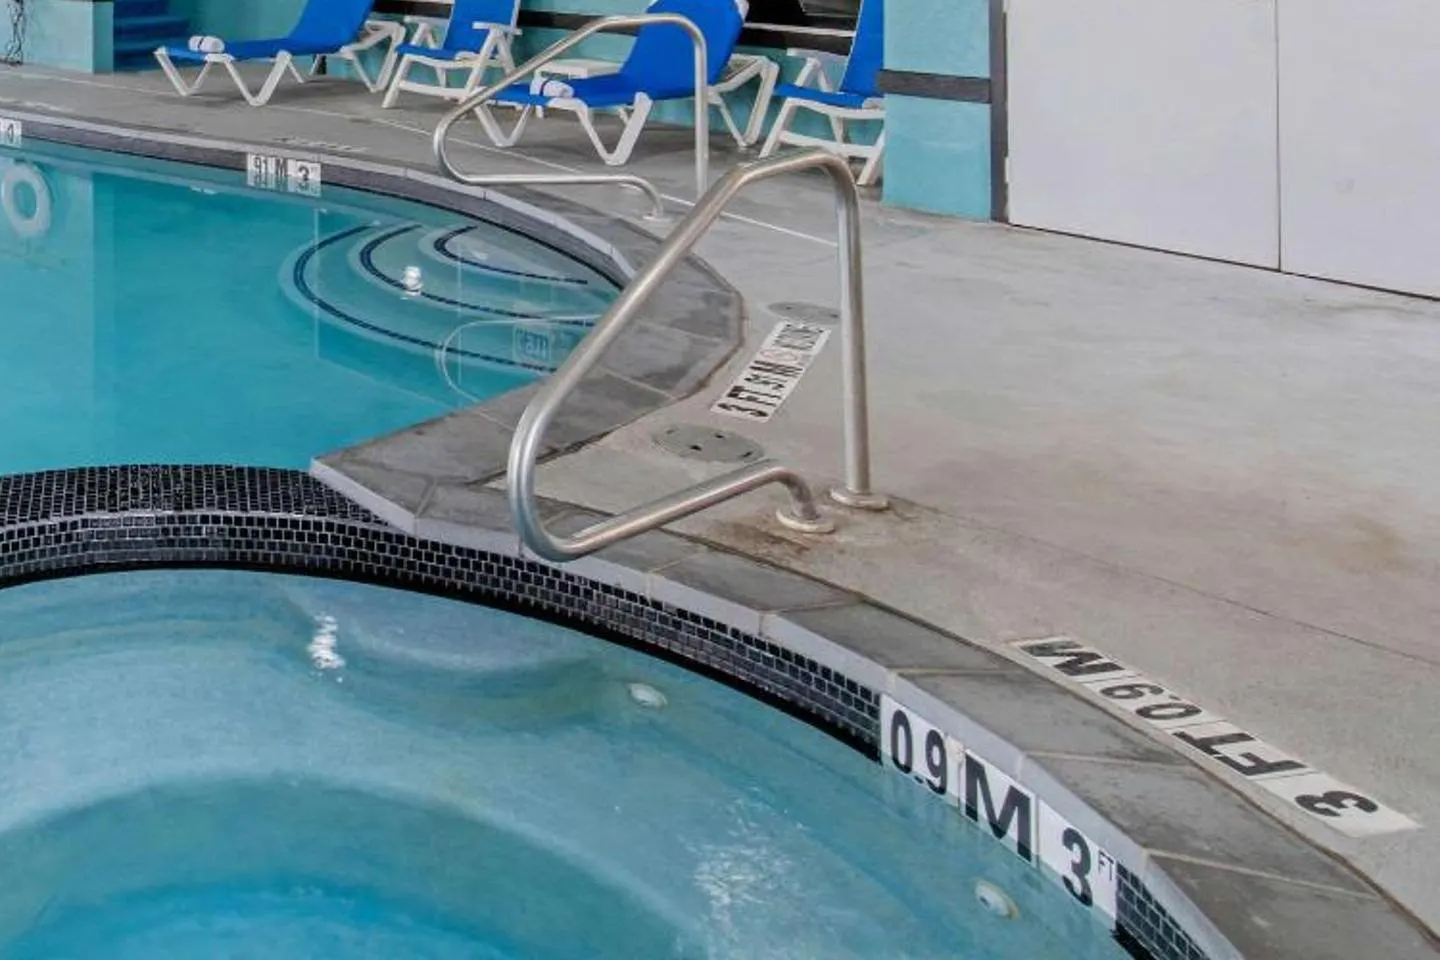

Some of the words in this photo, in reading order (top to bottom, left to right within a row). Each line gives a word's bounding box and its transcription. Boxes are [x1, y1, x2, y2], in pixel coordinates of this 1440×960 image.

[717, 403, 768, 417] 3
[1019, 639, 1126, 677] M
[1172, 730, 1309, 777] FT
[1294, 789, 1378, 819] 3
[964, 752, 1032, 863] M
[1061, 827, 1093, 908] 3
[1098, 849, 1115, 882] FT
